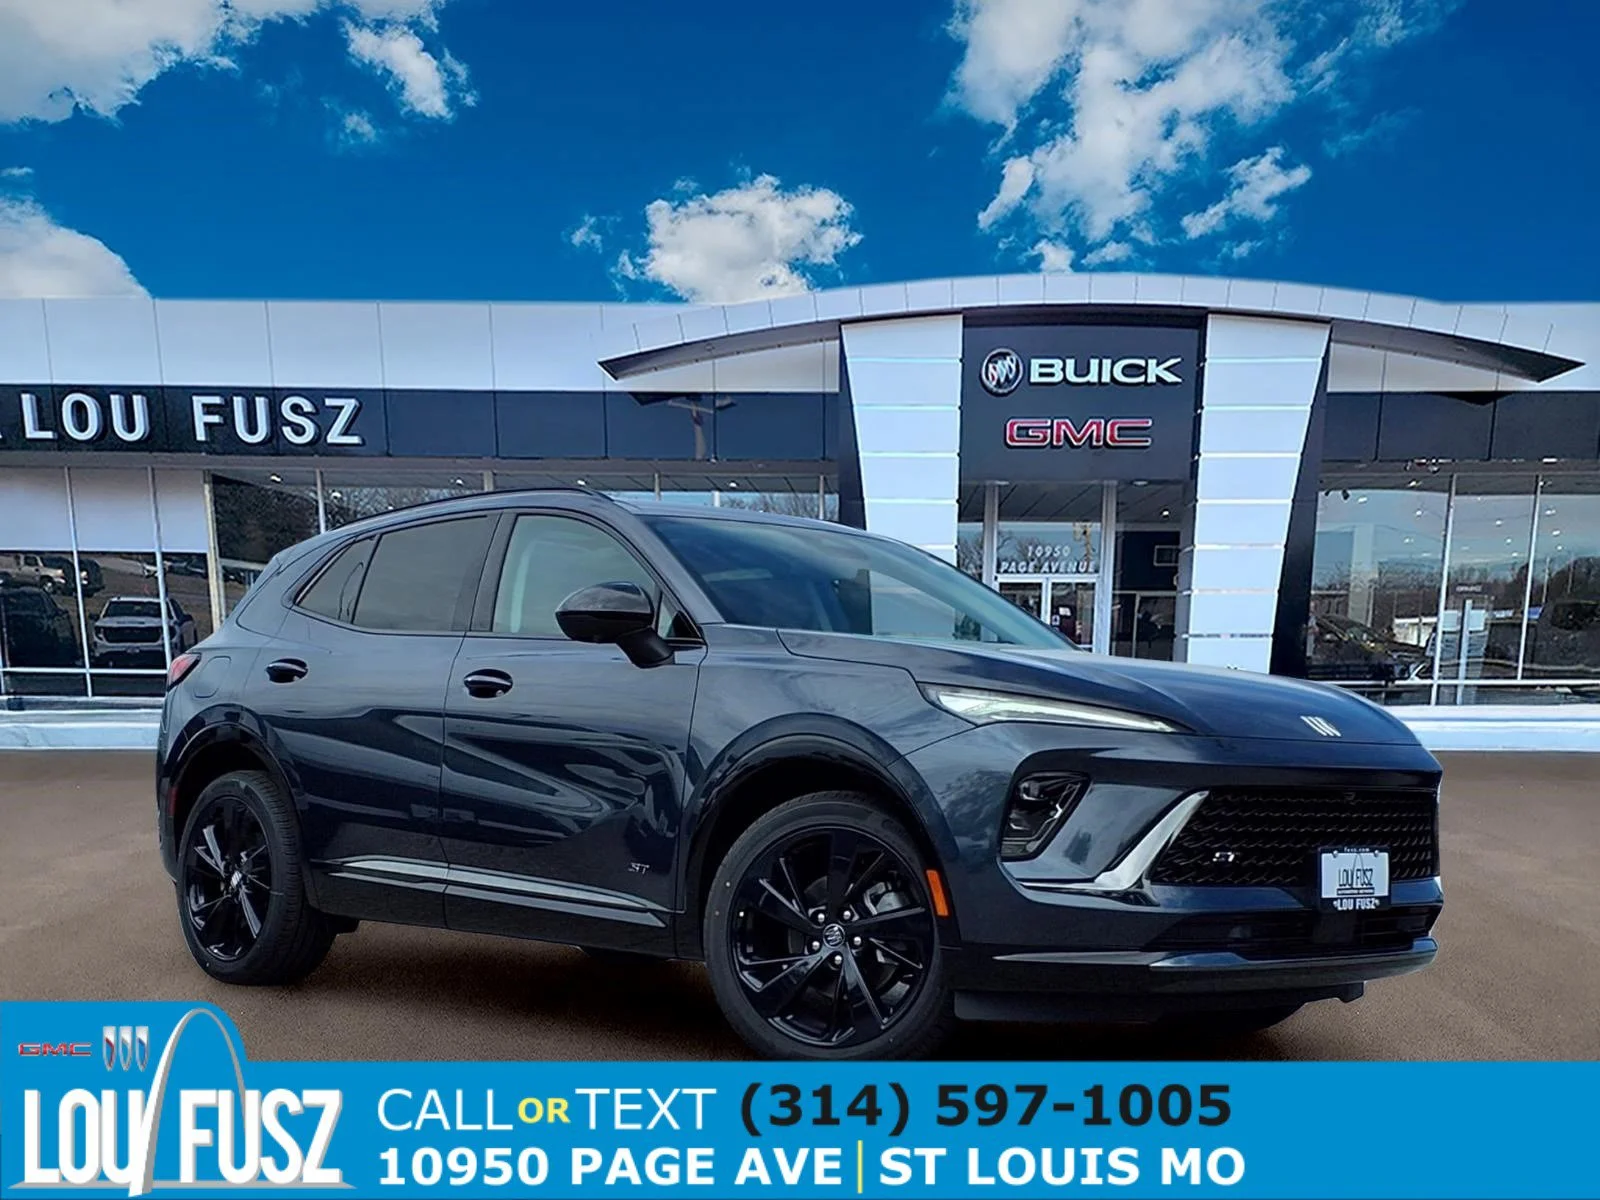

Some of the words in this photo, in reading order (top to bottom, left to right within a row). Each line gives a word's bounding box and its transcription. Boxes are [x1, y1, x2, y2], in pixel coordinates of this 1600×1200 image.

[1029, 356, 1183, 385] BUICK
[20, 392, 151, 442] LOU
[191, 394, 364, 446] FUSZ
[1006, 418, 1153, 447] GMC
[1027, 545, 1071, 558] 10950
[1000, 560, 1036, 573] PAGE
[1040, 561, 1096, 573] AVENUE
[1338, 868, 1354, 887] LOU
[1355, 868, 1374, 886] FUSZ
[1337, 898, 1354, 911] LOU
[1355, 898, 1376, 910] FUSZ
